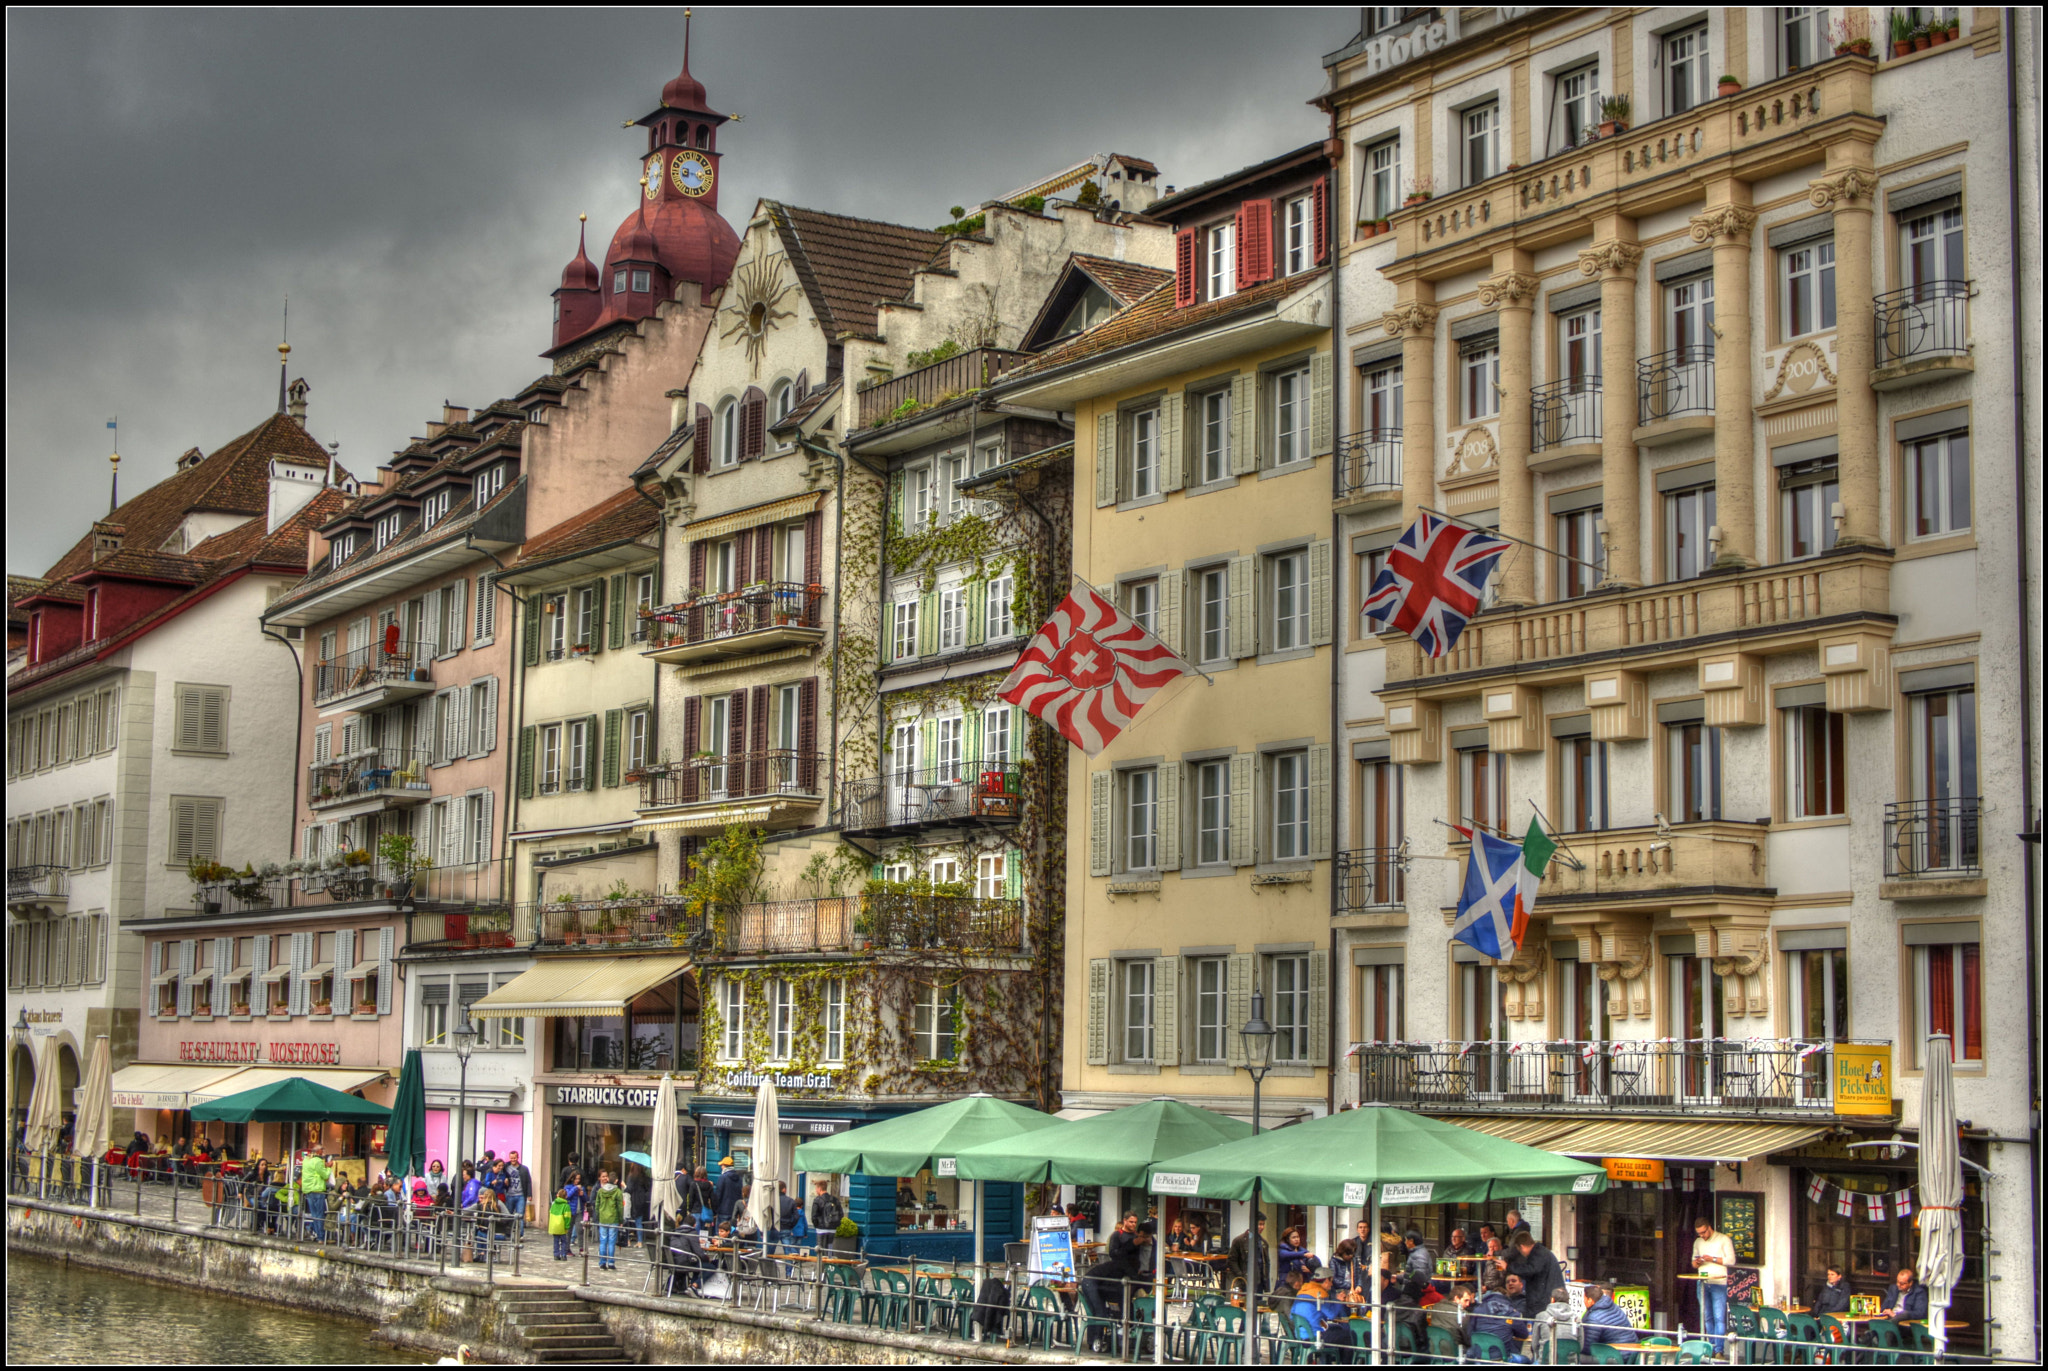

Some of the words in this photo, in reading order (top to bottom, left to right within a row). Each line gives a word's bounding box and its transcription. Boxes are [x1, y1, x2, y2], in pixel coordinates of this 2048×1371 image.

[1365, 8, 1461, 76] Hotel
[1786, 358, 1817, 380] 2001
[1464, 440, 1488, 458] 1908
[26, 1008, 42, 1023] athaus
[179, 1041, 257, 1061] RESTAURANT
[268, 1042, 336, 1063] MOSTROSE
[1840, 1060, 1865, 1077] Hotel
[774, 1072, 803, 1088] Team
[807, 1072, 831, 1089] Graf
[1840, 1078, 1886, 1095] Pickwick
[557, 1086, 625, 1106] STARBUCKS
[626, 1089, 659, 1107] COFF
[713, 1118, 733, 1127] DAMEN
[810, 1124, 835, 1132] HERREN
[1618, 1294, 1644, 1309] Geiz
